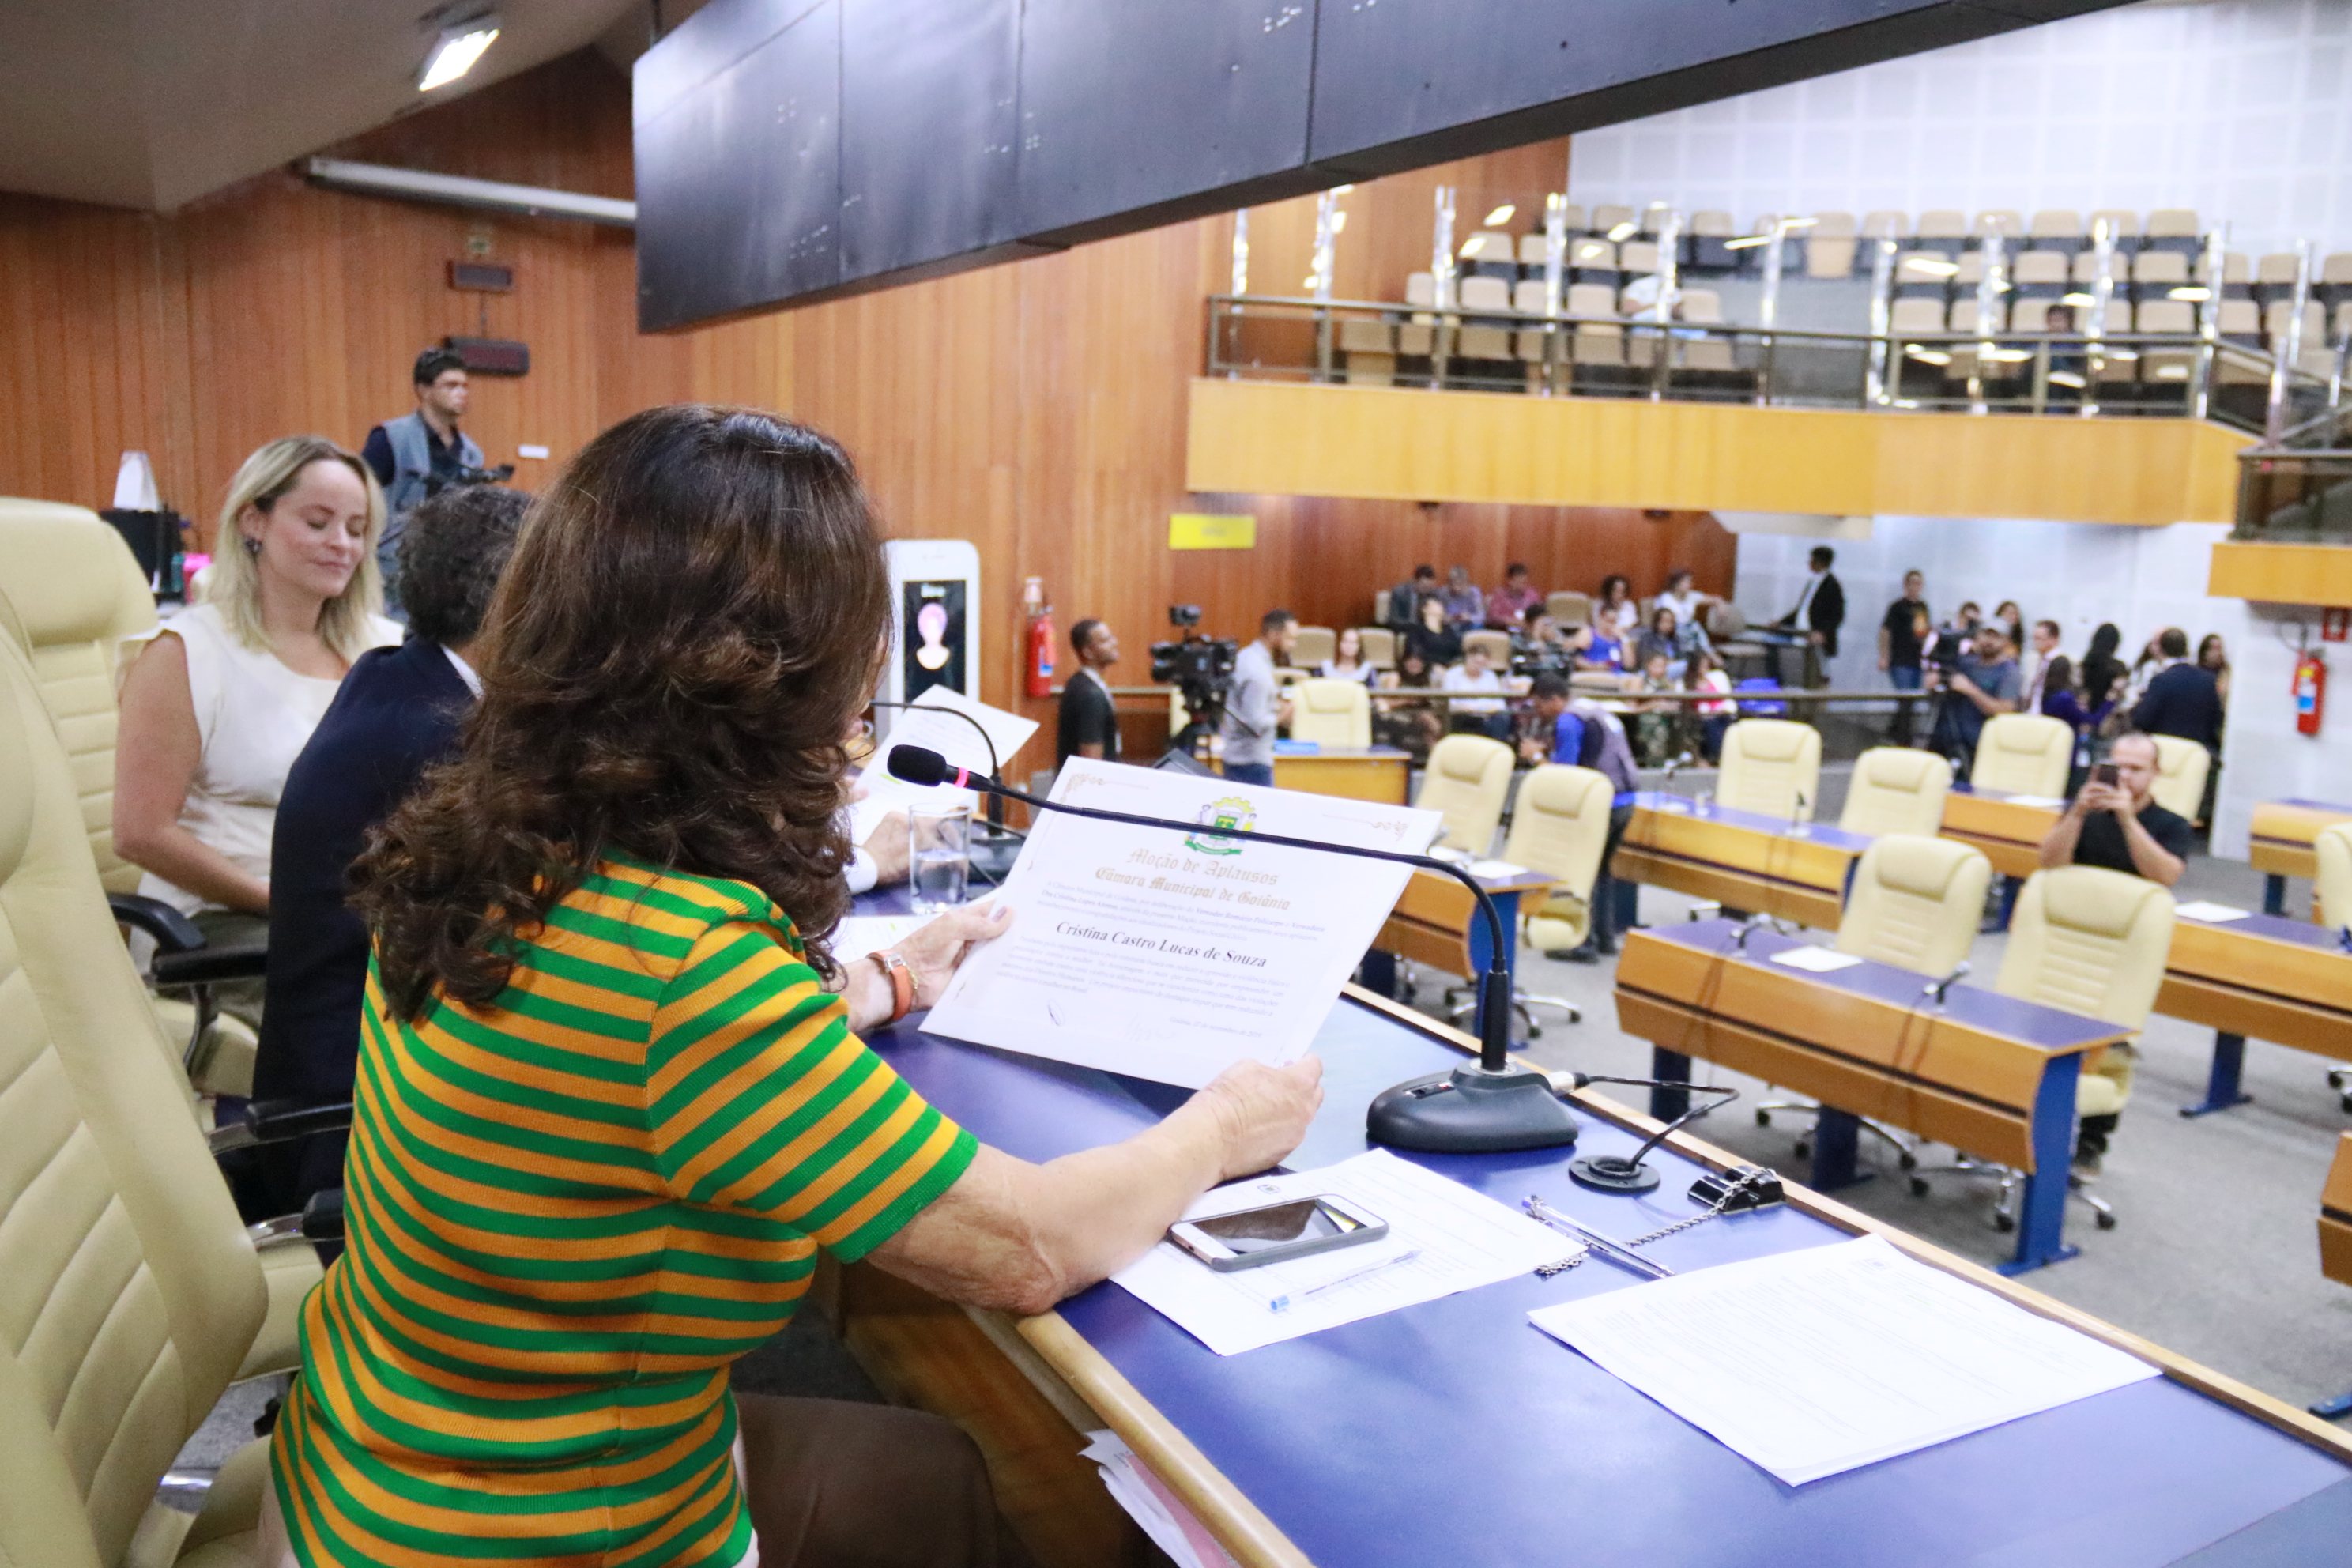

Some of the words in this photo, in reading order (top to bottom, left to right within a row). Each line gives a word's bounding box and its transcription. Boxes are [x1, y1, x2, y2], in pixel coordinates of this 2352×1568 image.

[1204, 861, 1277, 884] Aplausos
[1149, 876, 1215, 898] Municipal
[1218, 888, 1233, 901] de
[1238, 891, 1290, 910] Goiânia
[1057, 922, 1107, 940] Cristina
[1111, 931, 1155, 949] Castro
[1159, 939, 1200, 956] Lucas
[1203, 947, 1220, 959] de
[1223, 950, 1266, 967] Souza
